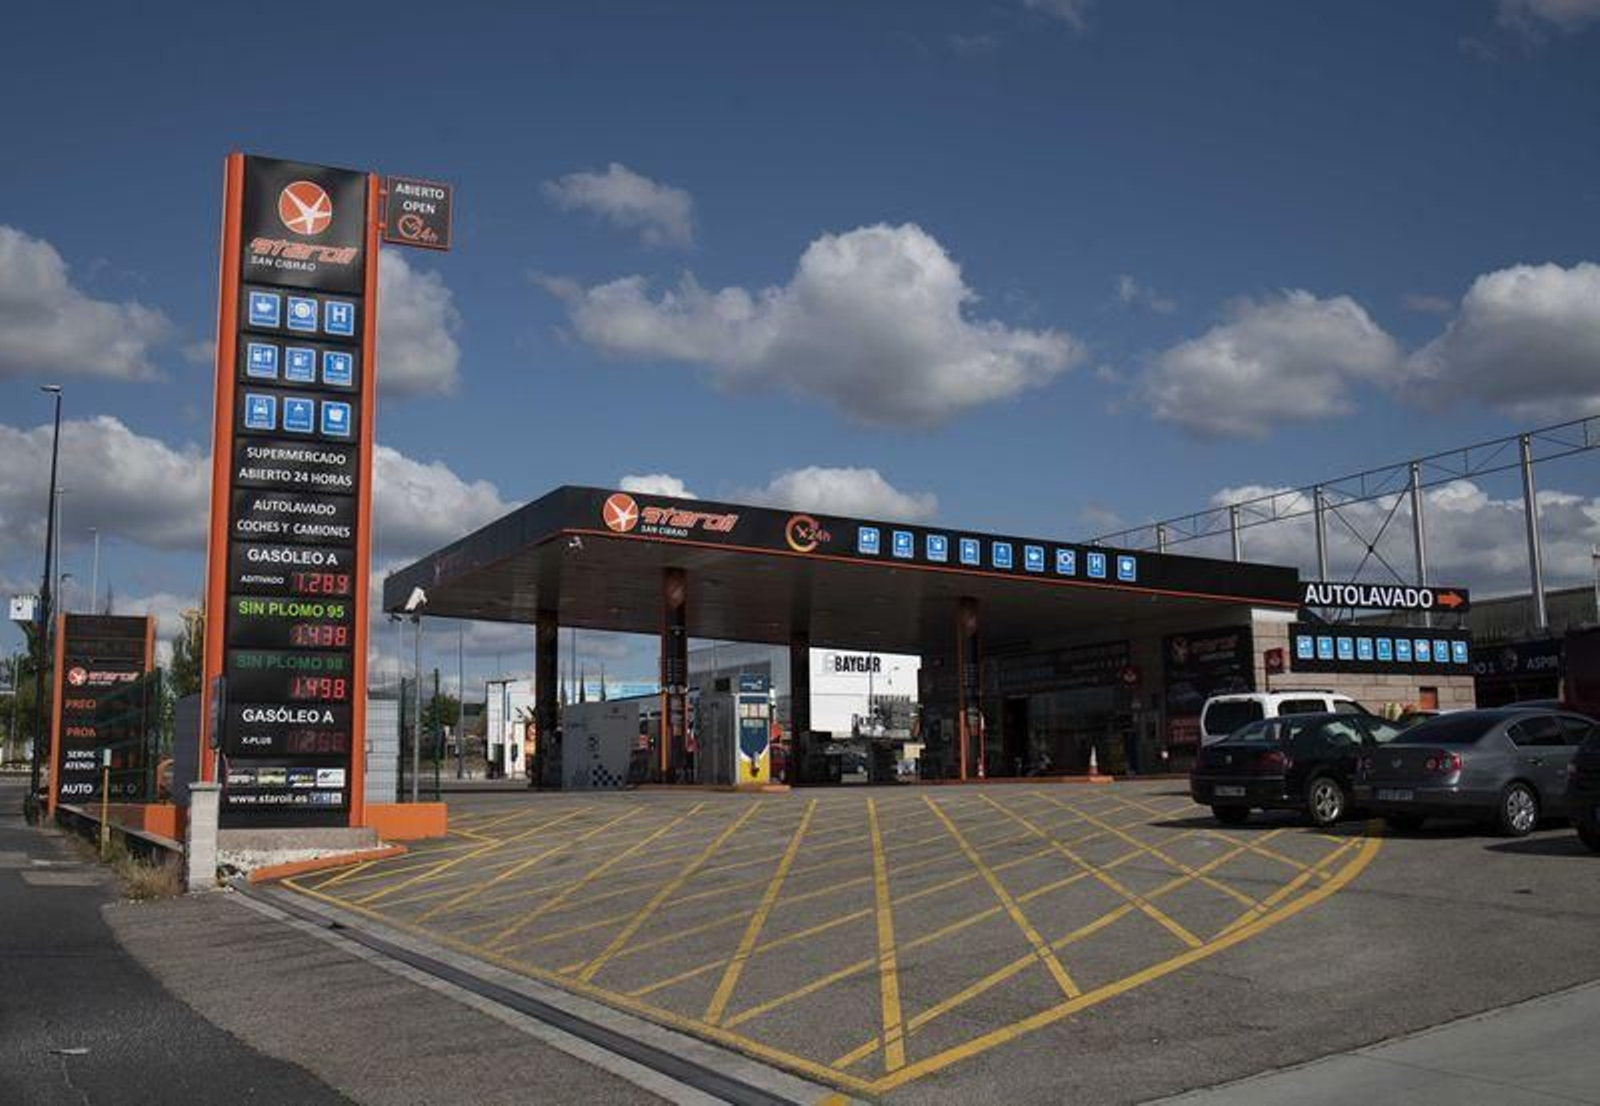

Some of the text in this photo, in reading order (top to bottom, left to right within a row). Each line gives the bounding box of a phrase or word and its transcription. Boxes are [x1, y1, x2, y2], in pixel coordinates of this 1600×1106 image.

[395, 183, 444, 200] ABIERTO
[403, 200, 436, 214] OPEN
[251, 255, 316, 272] SAN CIBRAO
[247, 447, 346, 465] SUPERMERCADO
[238, 467, 352, 487] ABIERTO 24 HORAS
[253, 500, 336, 516] AUTOLAVADO
[237, 519, 350, 539] COCHES Y CAMIONES
[640, 525, 657, 534] SAN
[807, 530, 831, 542] 24h
[247, 547, 338, 566] GASÓLEO A
[240, 575, 285, 585] ADITIVADO
[1304, 583, 1434, 609] AUTOLAVADO
[238, 600, 344, 619] SIN PLOMO 95
[236, 655, 262, 669] SIN
[267, 656, 323, 671] PLOMO
[834, 655, 881, 673] BAYGAR
[242, 706, 334, 724] GASÓLEO A
[228, 792, 308, 804] www.staroil.es
